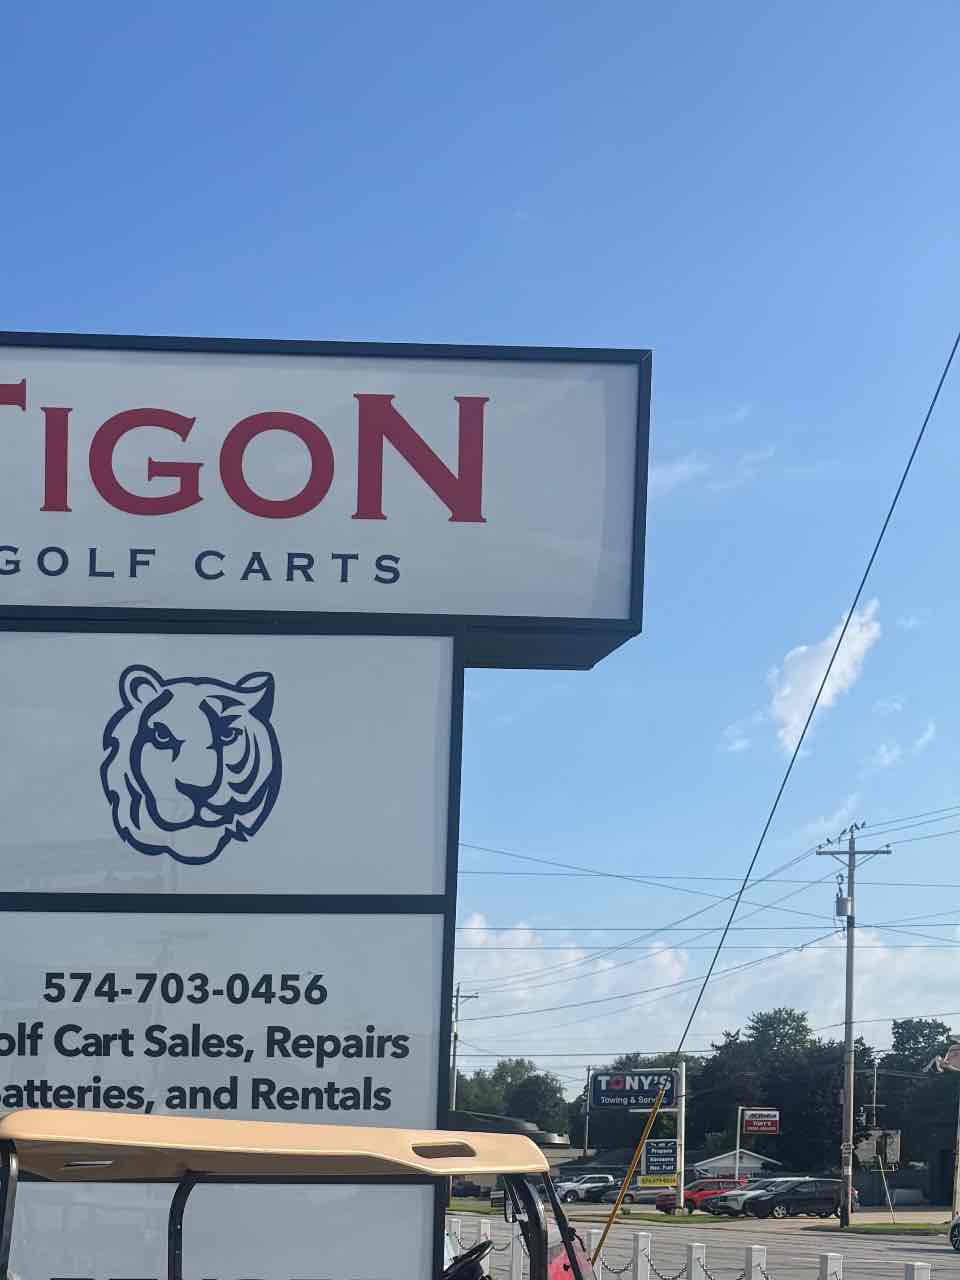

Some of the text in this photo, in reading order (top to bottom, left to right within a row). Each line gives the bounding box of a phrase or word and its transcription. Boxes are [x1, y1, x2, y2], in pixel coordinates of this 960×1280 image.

[194, 550, 402, 585] CARTS
[42, 972, 328, 1006] 574-703-0456
[53, 1023, 135, 1058] Cart
[143, 1023, 255, 1063] Sales,
[266, 1024, 410, 1069] Repairs
[164, 1075, 239, 1110] and
[251, 1076, 392, 1111] Rentals
[597, 1075, 671, 1090] TONY'S
[601, 1096, 628, 1105] Towing
